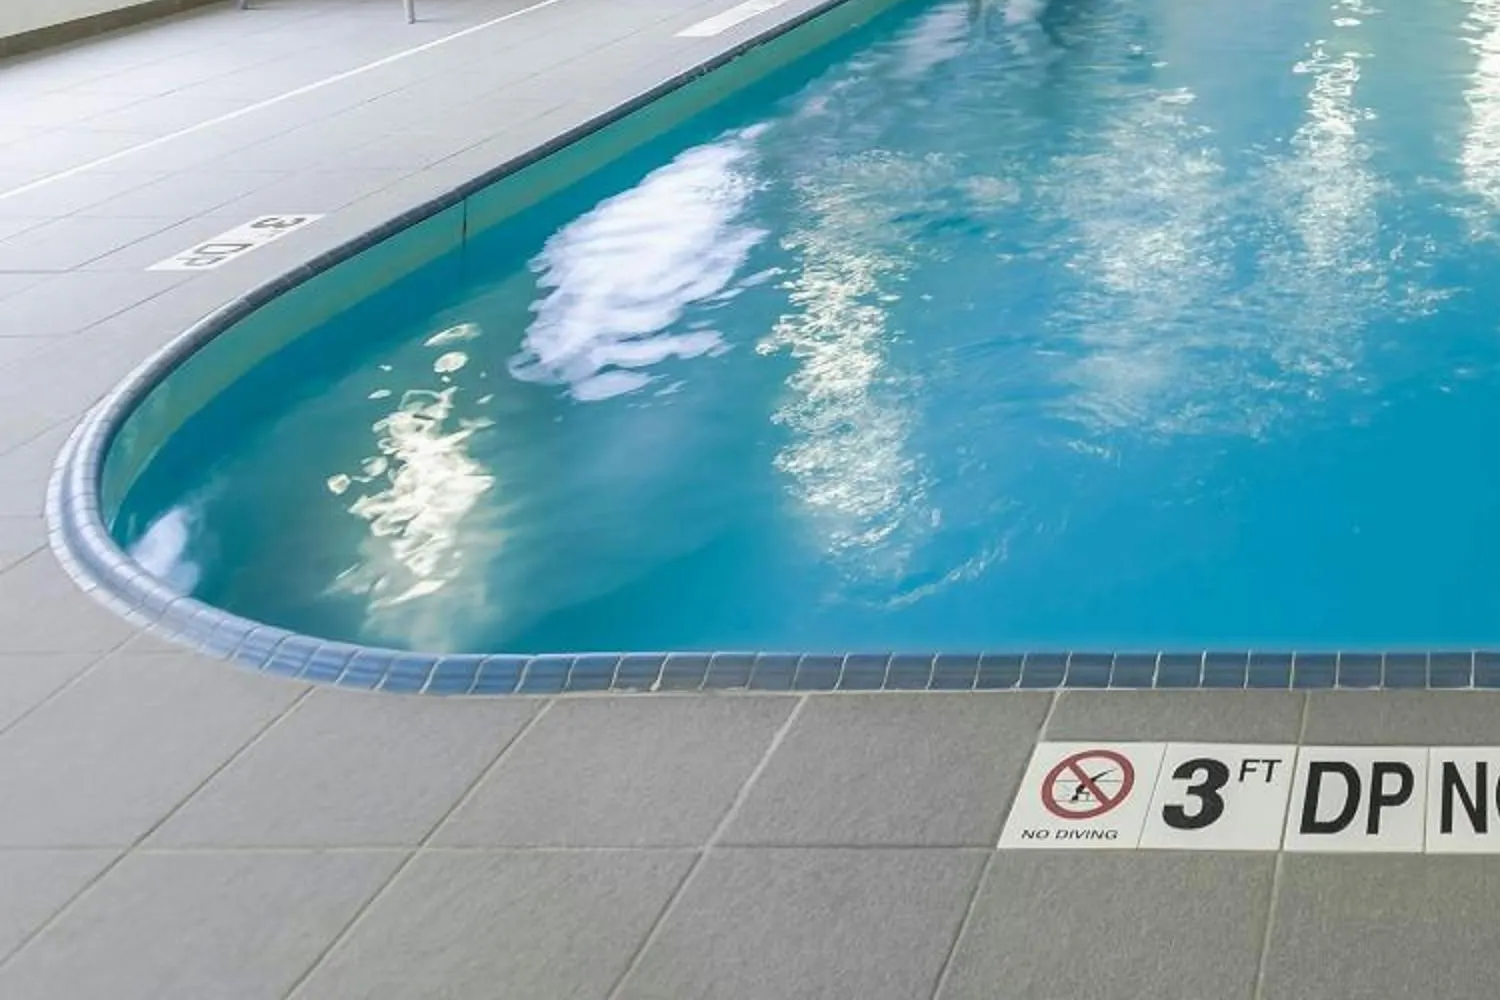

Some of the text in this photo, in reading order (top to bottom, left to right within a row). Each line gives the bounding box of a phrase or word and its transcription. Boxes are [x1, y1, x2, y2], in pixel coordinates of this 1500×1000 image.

[1162, 758, 1230, 830] 3
[1238, 759, 1282, 783] FT
[1300, 761, 1414, 834] DP
[1021, 829, 1119, 840] NO DIVING
